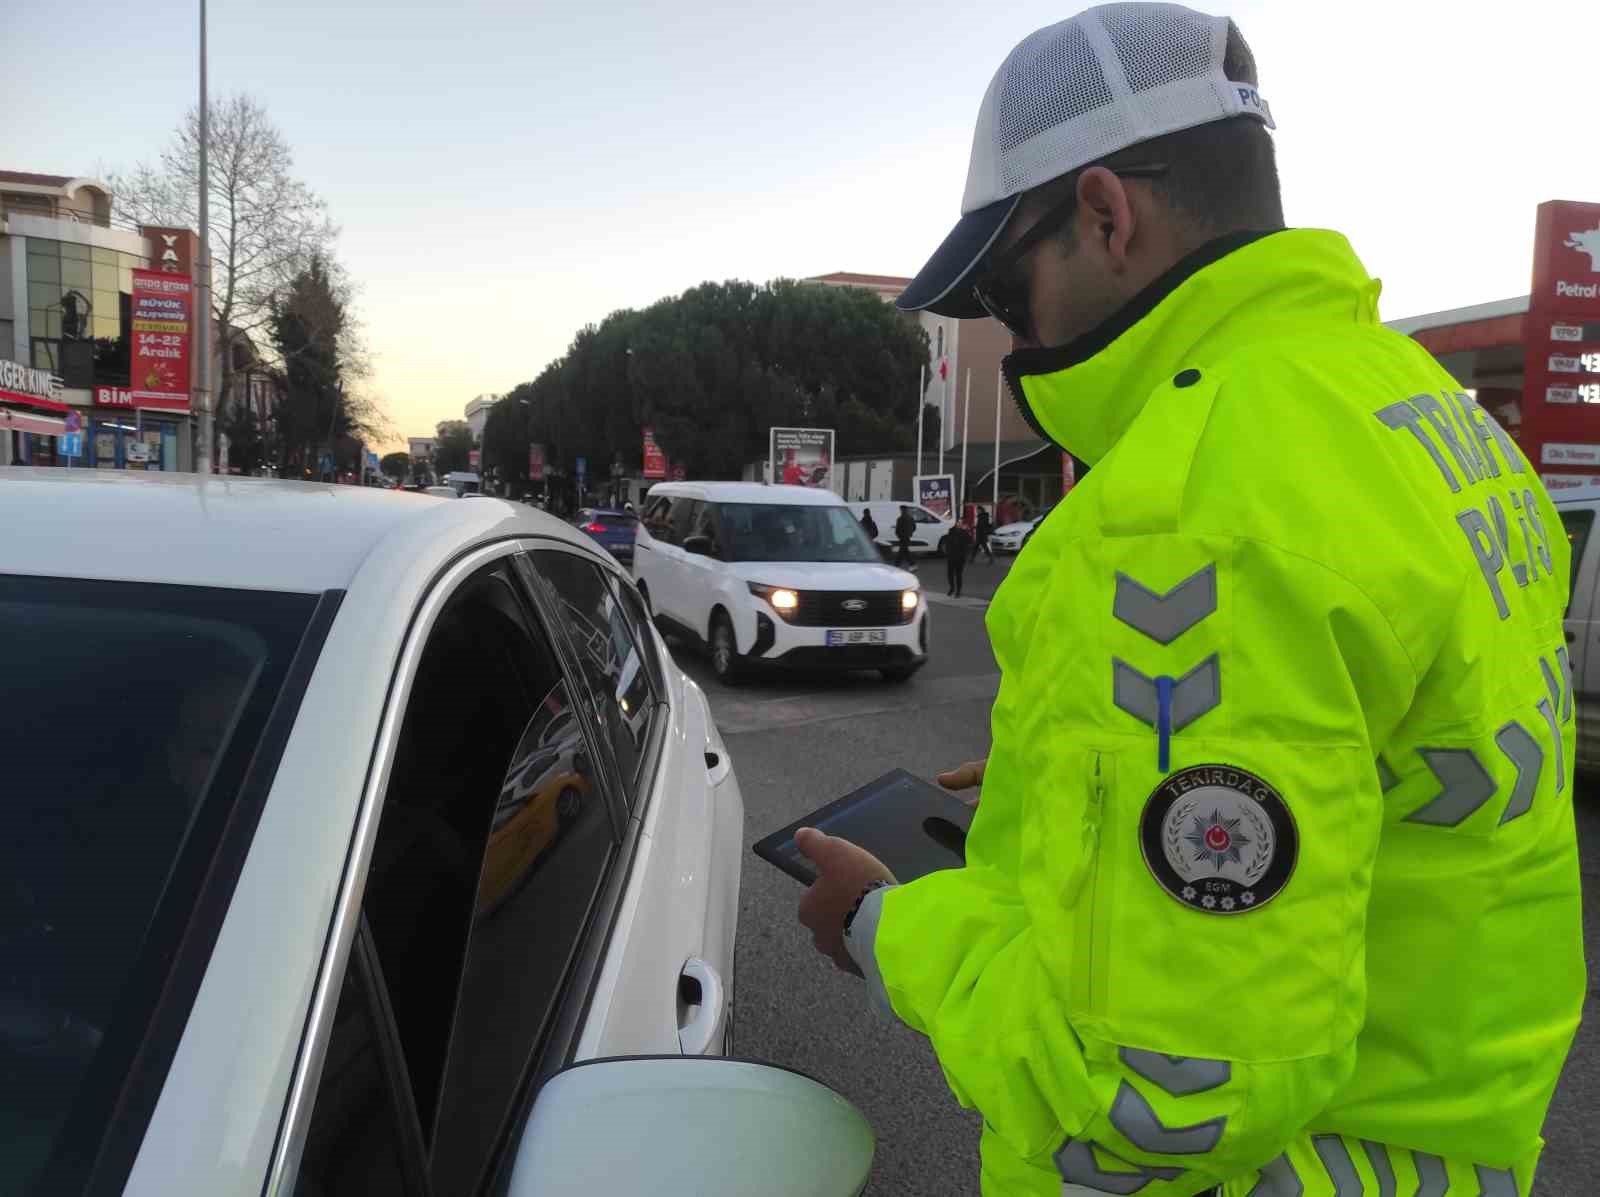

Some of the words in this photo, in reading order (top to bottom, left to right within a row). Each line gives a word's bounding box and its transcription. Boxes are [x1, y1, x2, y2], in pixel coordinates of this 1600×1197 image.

[1556, 281, 1597, 298] Petrol
[139, 334, 182, 346] 14-22
[139, 345, 182, 359] Aralık
[99, 387, 132, 404] BİM
[1205, 881, 1231, 893] EGM
